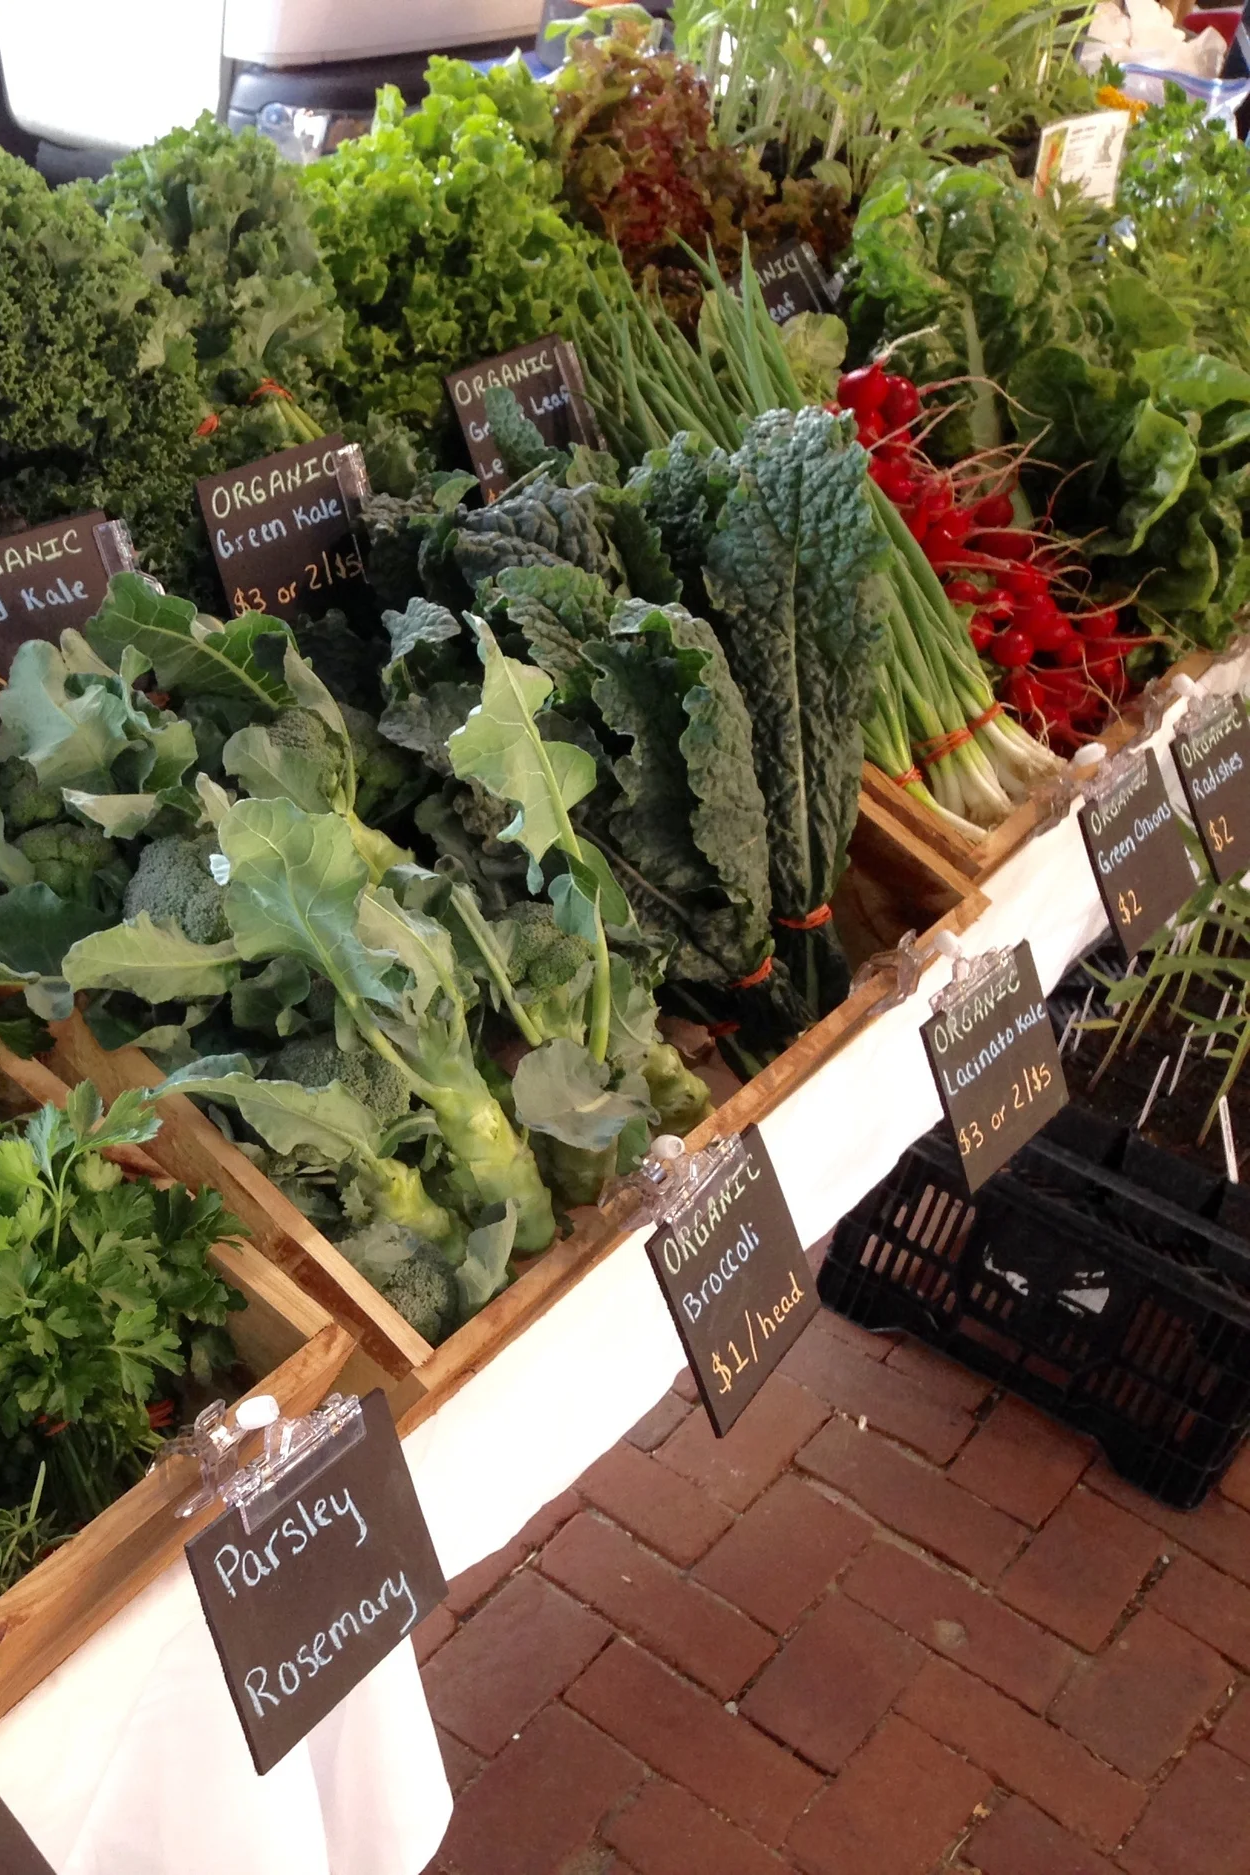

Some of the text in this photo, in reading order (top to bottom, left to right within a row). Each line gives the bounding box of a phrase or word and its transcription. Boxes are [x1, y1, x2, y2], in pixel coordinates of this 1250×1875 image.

[454, 350, 553, 406] ORGANIC
[530, 384, 570, 415] Leaf
[212, 451, 339, 518] ORGANIC
[216, 498, 342, 559] Green Kale
[21, 577, 89, 611] Kale
[234, 551, 362, 617] $3 or 2/$5
[1180, 707, 1243, 769] ORGANIC
[1090, 767, 1149, 836] ORGANIC
[1192, 751, 1243, 800] Radishes
[1097, 801, 1172, 875] Green Onions
[1209, 815, 1234, 852] $2
[1118, 889, 1142, 925] $2
[934, 970, 1020, 1055] ORGANIC
[942, 1001, 1046, 1096] Lacinato Kale
[958, 1062, 1051, 1156] $3 or 2/$5
[662, 1153, 761, 1275] ORGANIC
[682, 1221, 760, 1324] Broccoli
[711, 1271, 804, 1394] $1/head
[213, 1488, 368, 1597] Parsley
[244, 1571, 418, 1718] Rosemary
